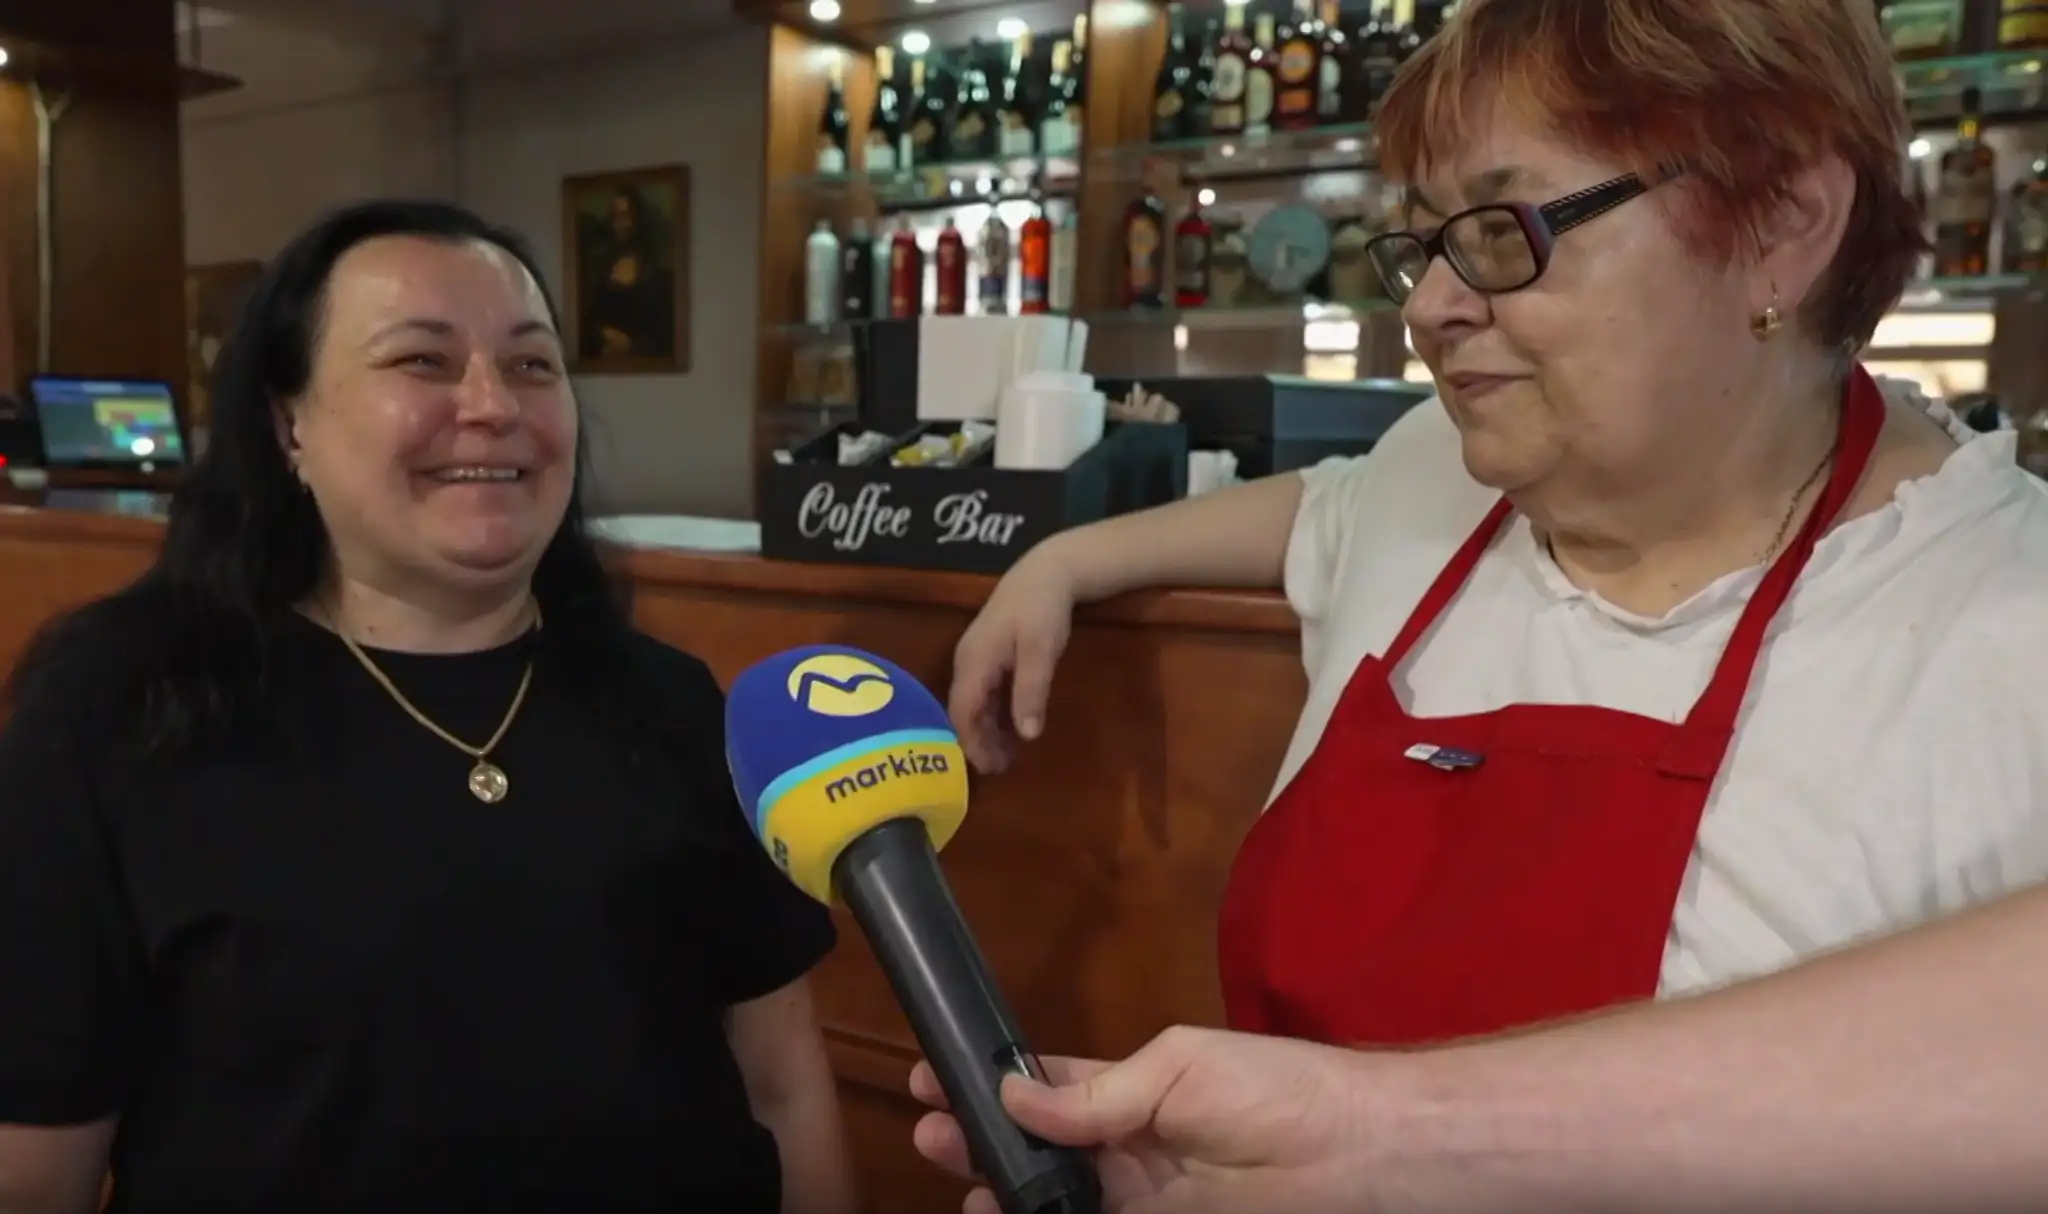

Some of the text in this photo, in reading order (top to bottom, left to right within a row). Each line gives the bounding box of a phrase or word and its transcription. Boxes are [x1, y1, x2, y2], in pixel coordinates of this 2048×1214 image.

[798, 481, 1025, 551] Coffee Bar
[824, 748, 949, 804] markiza
